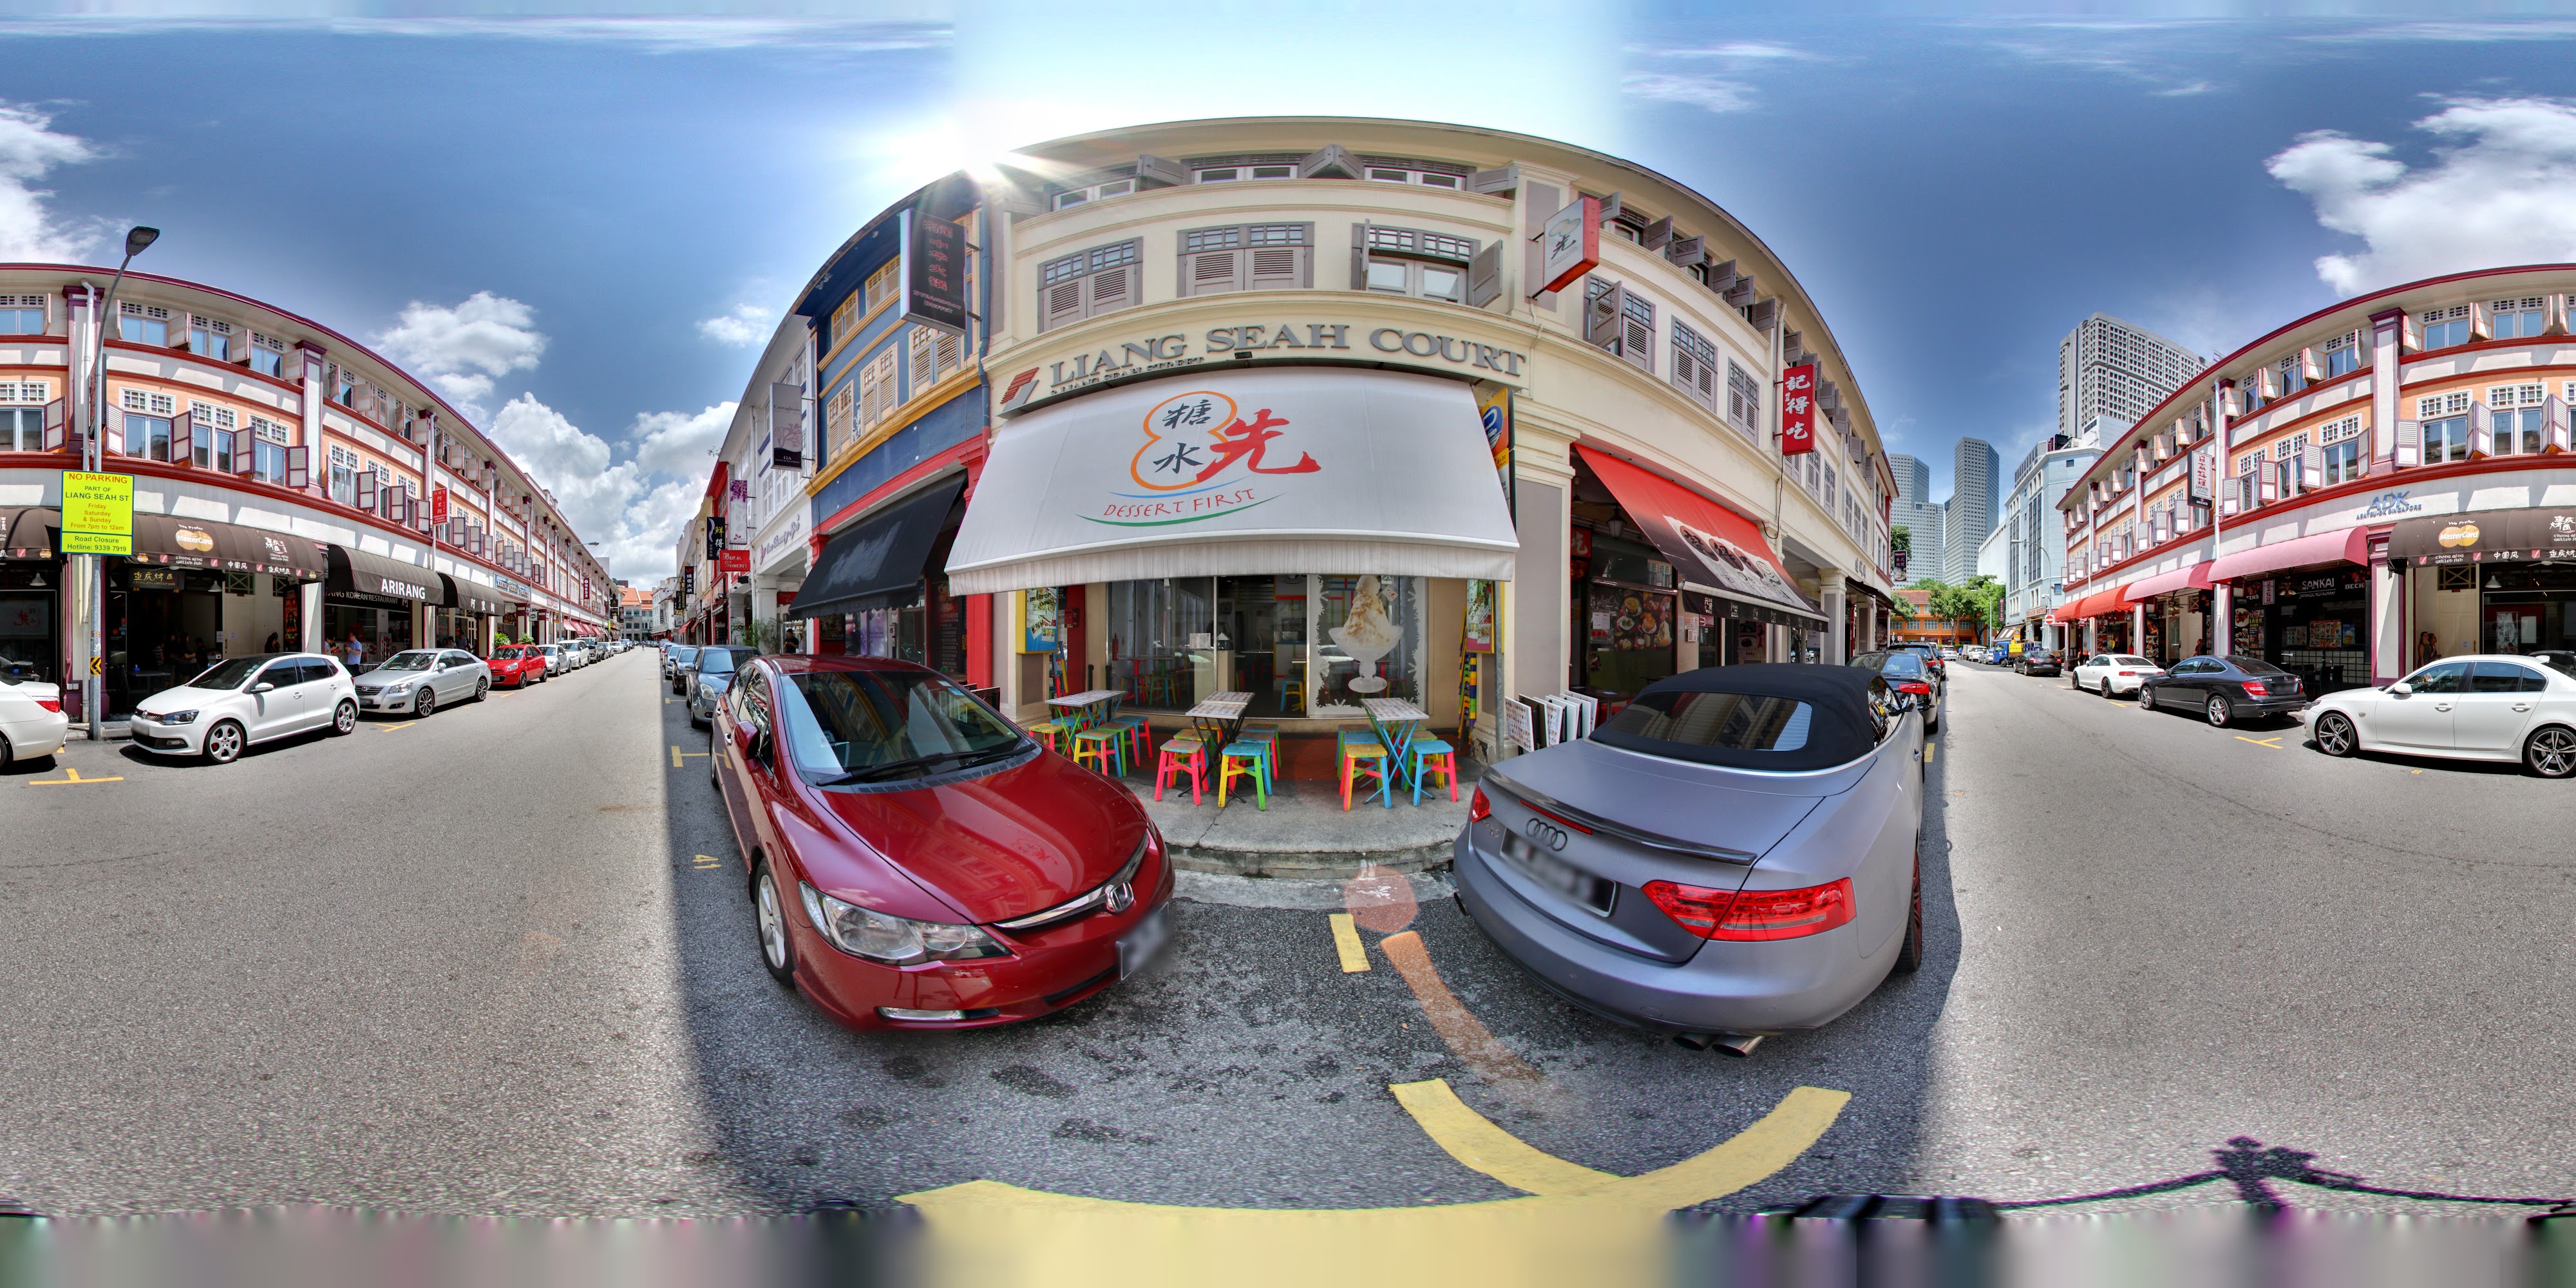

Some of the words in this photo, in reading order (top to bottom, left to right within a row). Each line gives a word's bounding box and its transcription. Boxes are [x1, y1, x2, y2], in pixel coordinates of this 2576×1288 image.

[1050, 334, 1186, 388] LIANG
[1207, 324, 1350, 352] SEAH
[1370, 328, 1526, 377] COURT
[1785, 375, 1811, 440] 記得吃
[1196, 408, 1322, 482] 先
[2197, 455, 2207, 487] 日本料理
[86, 474, 128, 484] PARKING
[1104, 501, 1184, 518] DESSERT
[1195, 488, 1256, 513] FIRST
[2367, 491, 2410, 512] ADK
[2388, 504, 2422, 515] SINGAPORE
[177, 535, 212, 545] MasterCard
[2439, 531, 2479, 541] MasterCard
[2494, 551, 2519, 560] 中国风
[227, 560, 247, 569] 中国风
[2302, 577, 2334, 589] SANKAI
[381, 579, 426, 600] ARIRANG
[368, 595, 398, 605] RESTAURANT
